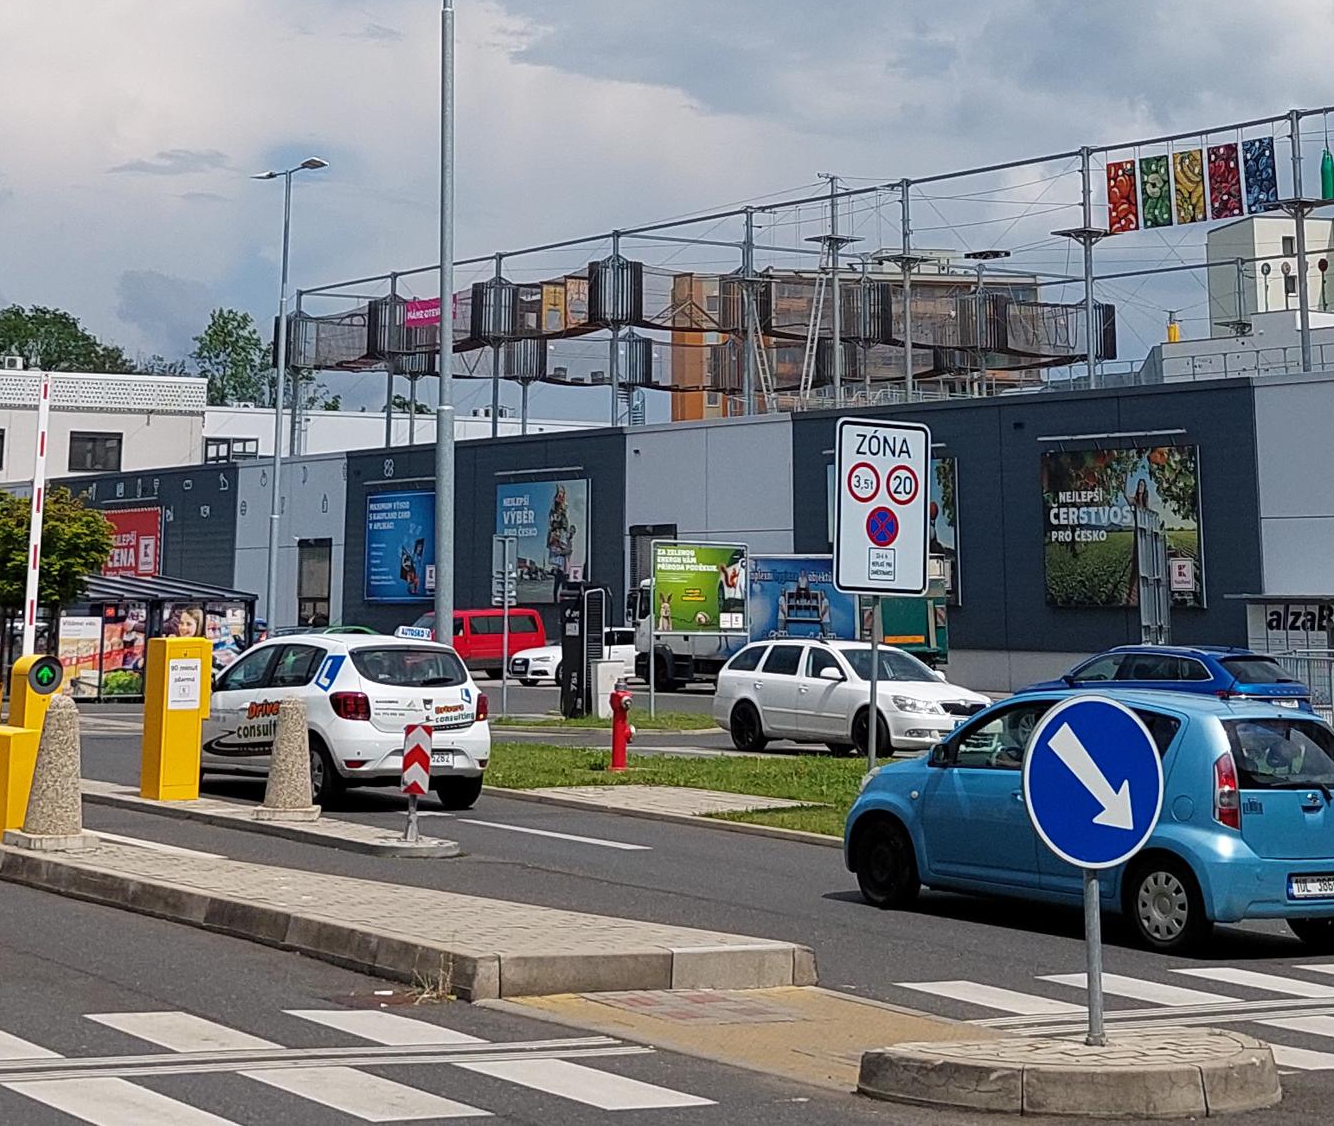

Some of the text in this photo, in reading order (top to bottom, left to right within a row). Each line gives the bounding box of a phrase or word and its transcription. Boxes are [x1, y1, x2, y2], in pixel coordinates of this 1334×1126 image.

[855, 429, 912, 459] ZÓNA
[853, 474, 874, 491] 3,5t
[893, 475, 913, 495] 20
[1058, 487, 1103, 504] NEJLEPŠÍ
[503, 507, 535, 525] VÝBĚR
[1049, 498, 1135, 526] ČERSTVOS
[1052, 527, 1107, 542] PRO ČESKO
[107, 547, 136, 568] CENA
